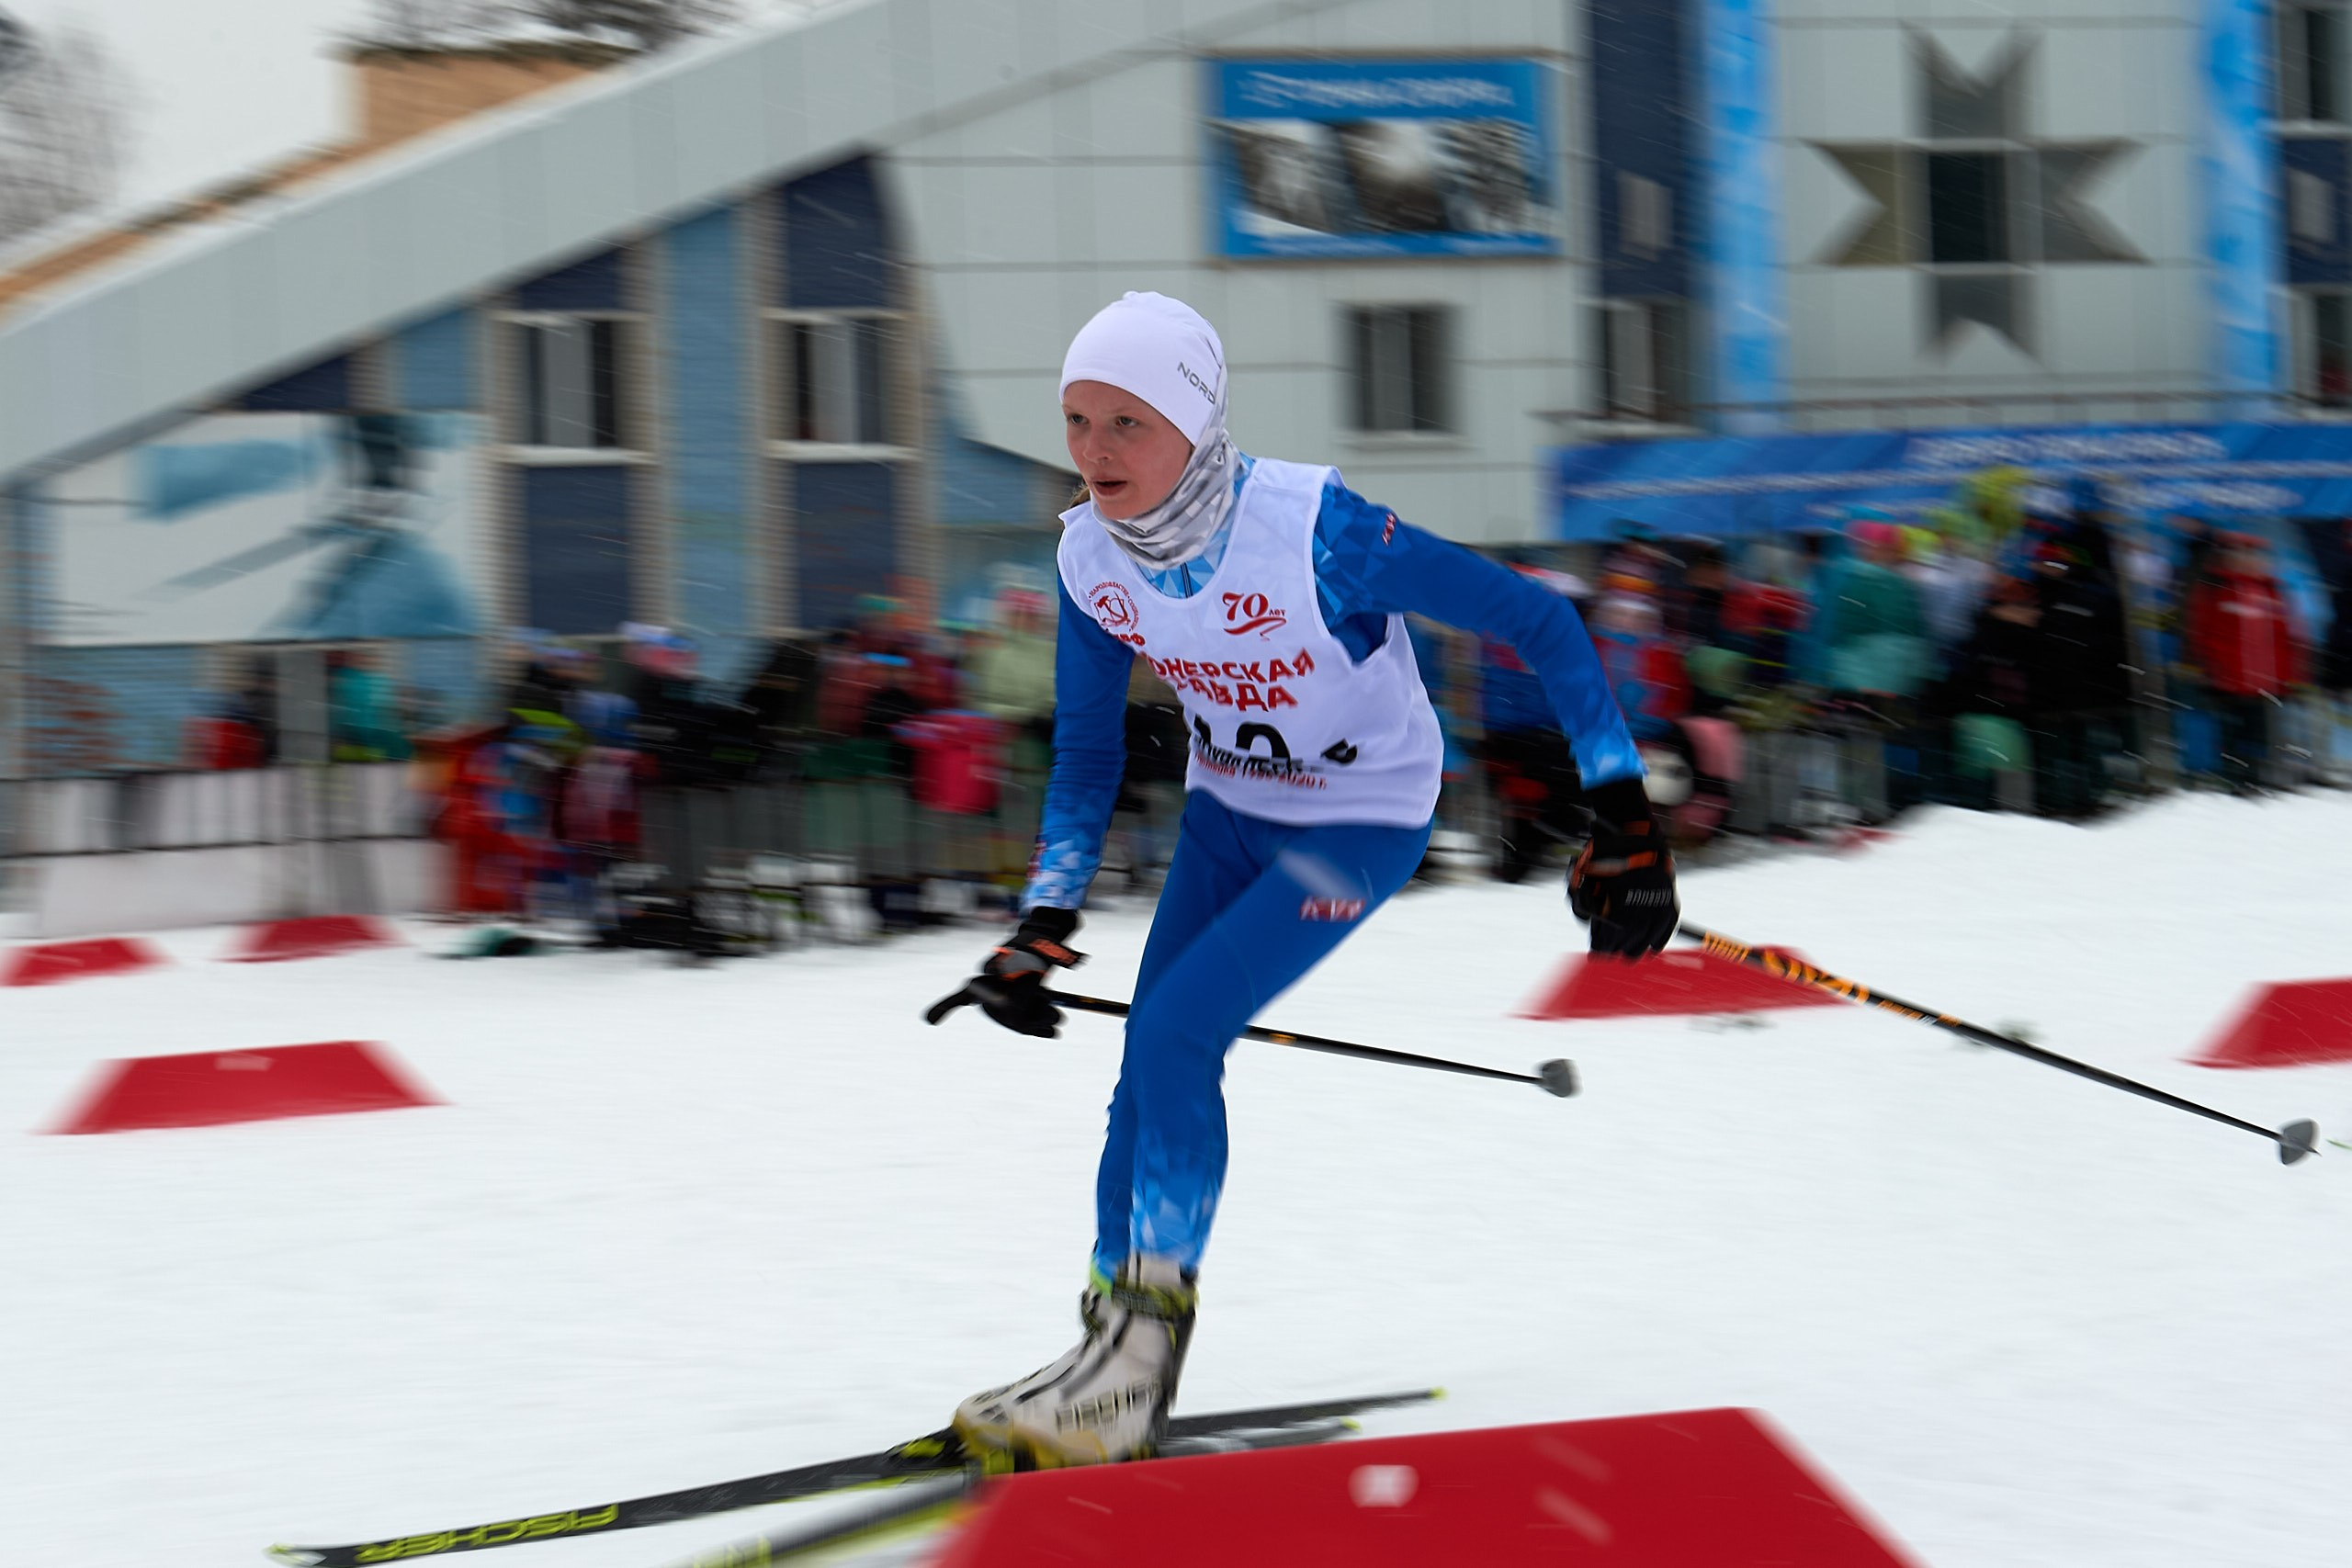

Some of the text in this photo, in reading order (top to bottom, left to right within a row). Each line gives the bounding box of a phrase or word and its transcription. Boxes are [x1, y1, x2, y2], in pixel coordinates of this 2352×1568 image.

[1177, 361, 1216, 405] NORD
[1222, 592, 1269, 621] 70
[355, 1503, 618, 1562] FISCHER
